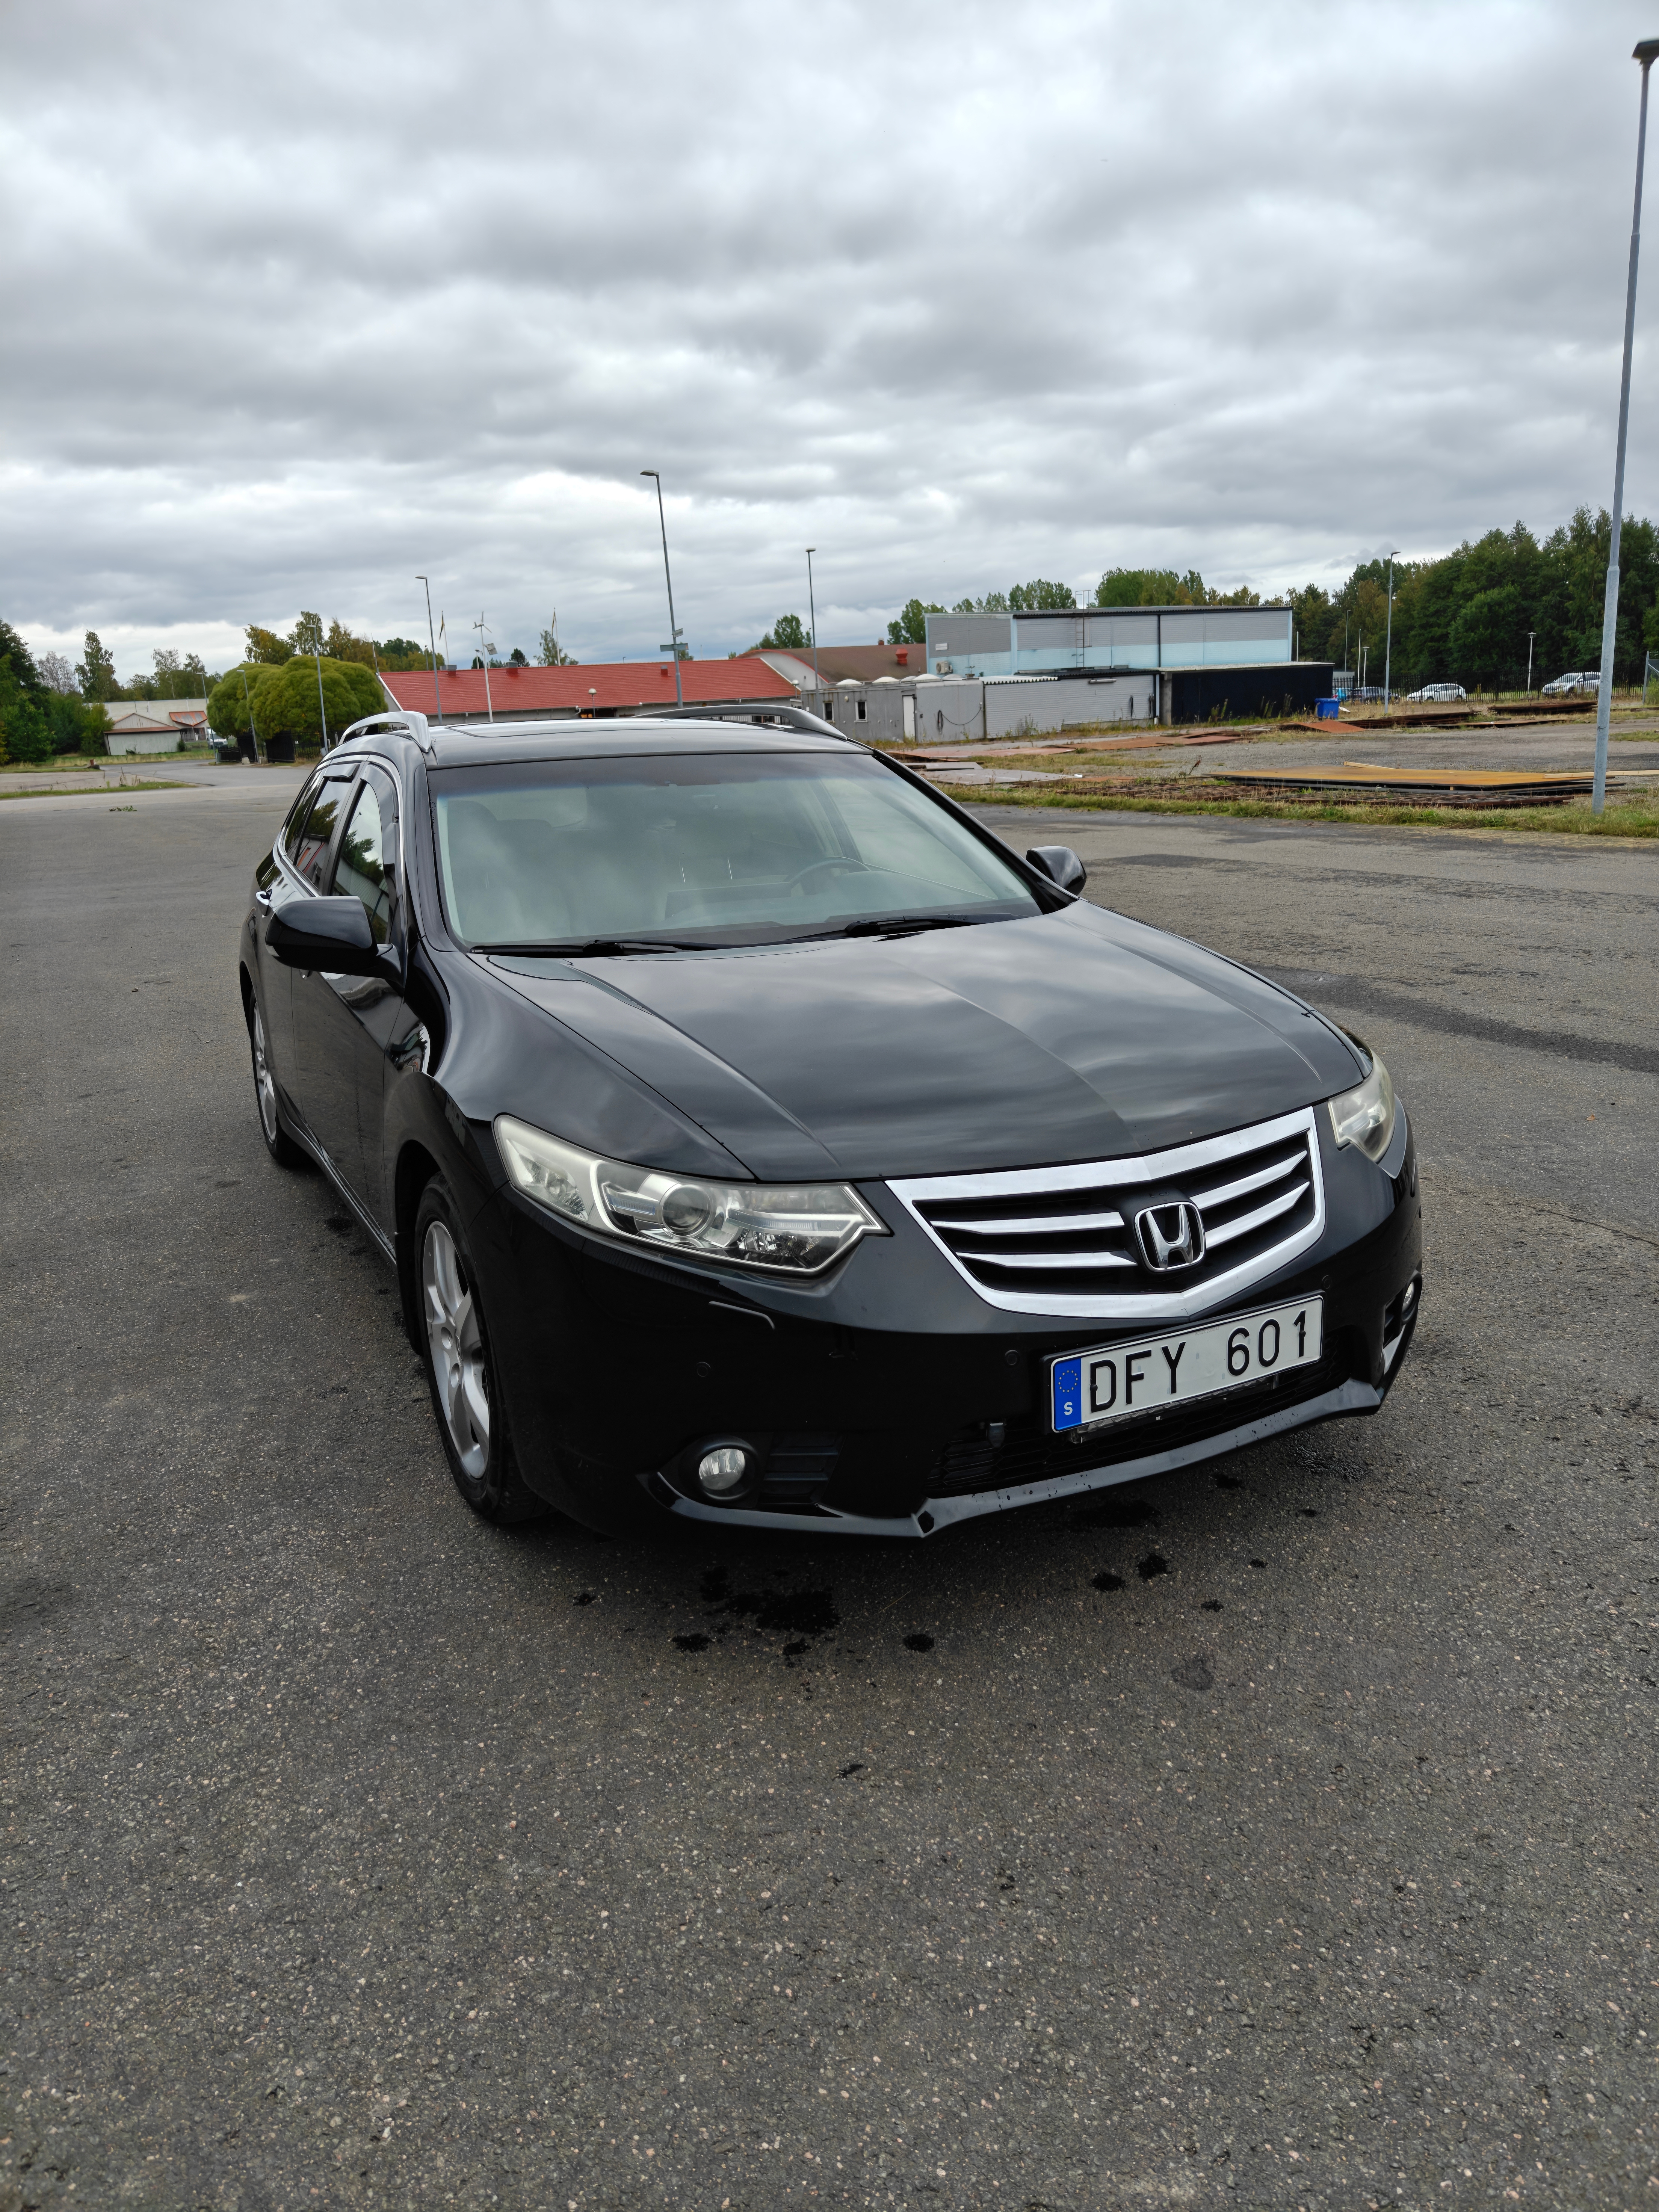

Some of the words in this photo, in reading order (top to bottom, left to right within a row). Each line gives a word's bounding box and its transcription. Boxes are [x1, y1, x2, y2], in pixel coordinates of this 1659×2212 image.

[1089, 1342, 1186, 1413] DFY
[1227, 1310, 1306, 1376] 601
[1064, 1401, 1073, 1416] S
